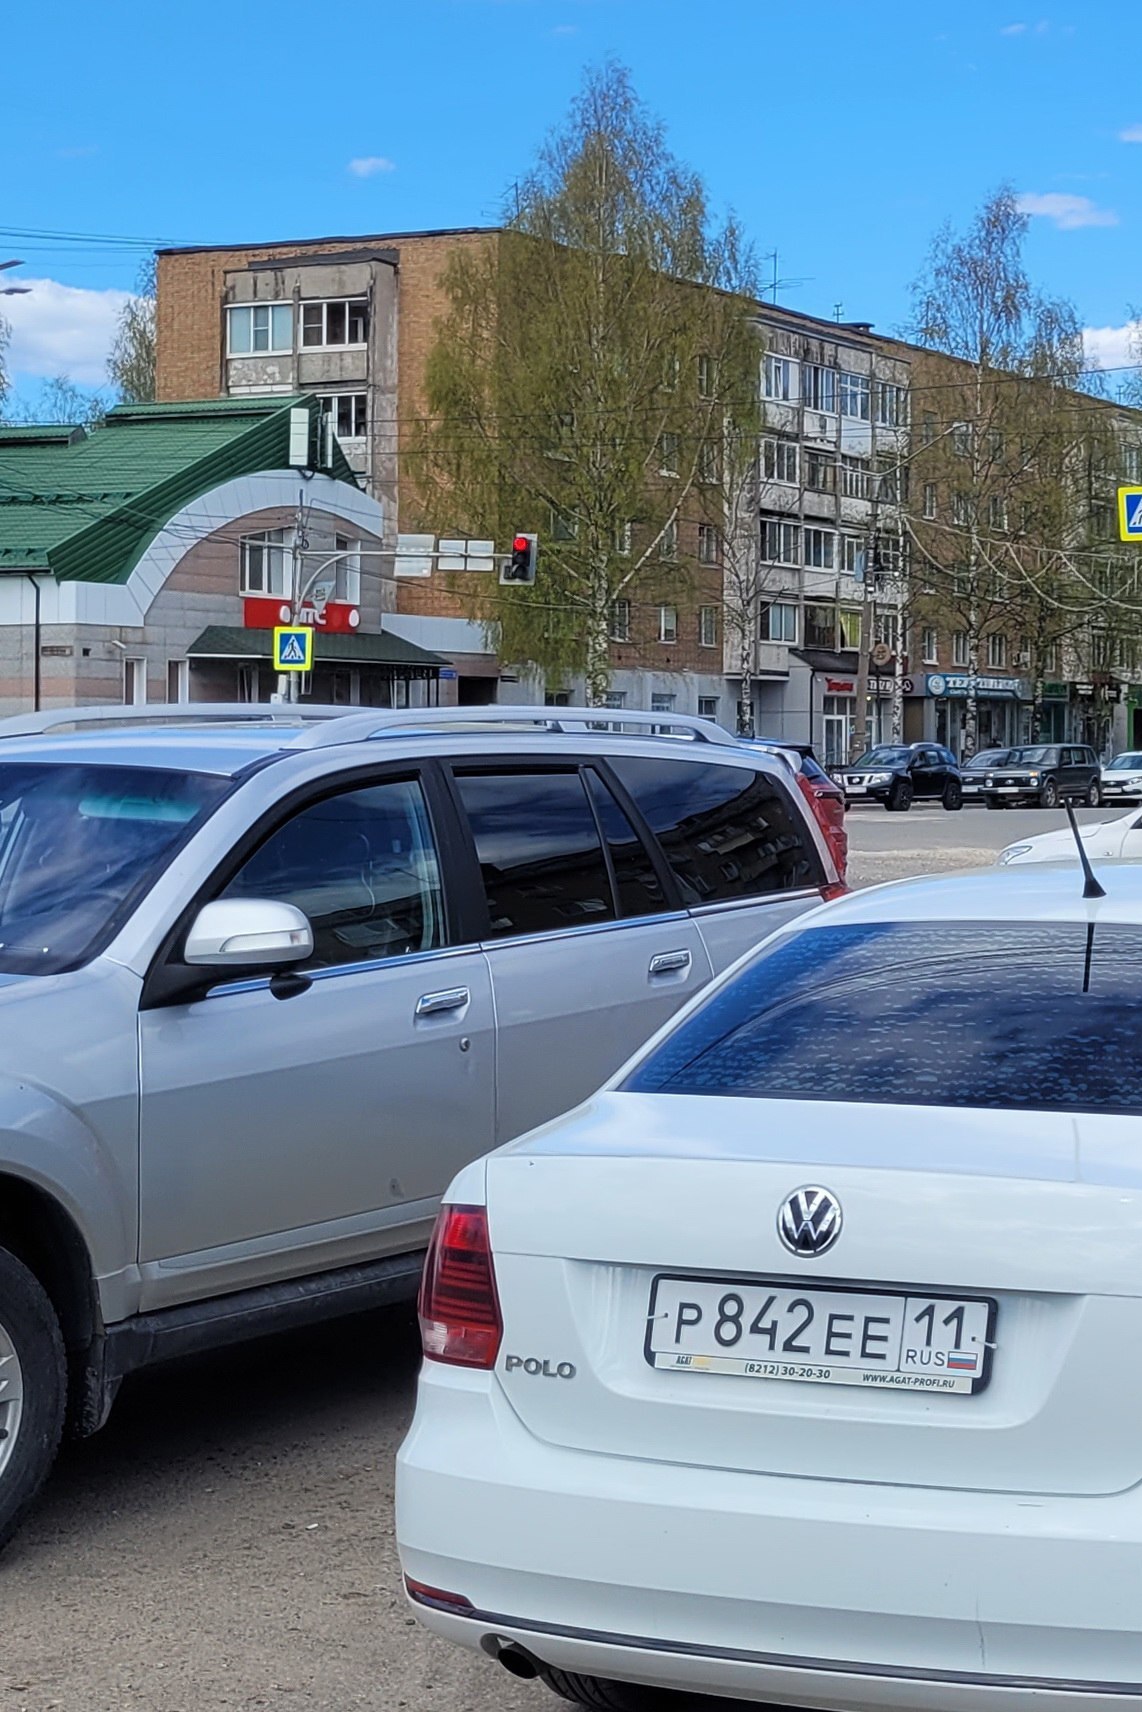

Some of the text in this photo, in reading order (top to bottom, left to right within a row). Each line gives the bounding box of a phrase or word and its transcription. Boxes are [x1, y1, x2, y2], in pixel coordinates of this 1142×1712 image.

[914, 1304, 965, 1350] 11
[675, 1355, 693, 1365] AGAT
[905, 1349, 945, 1367] RUS
[505, 1355, 577, 1379] POLO
[781, 1364, 831, 1379] 30-20-30
[862, 1373, 955, 1389] WWW.AGAT-PROFI.RU
